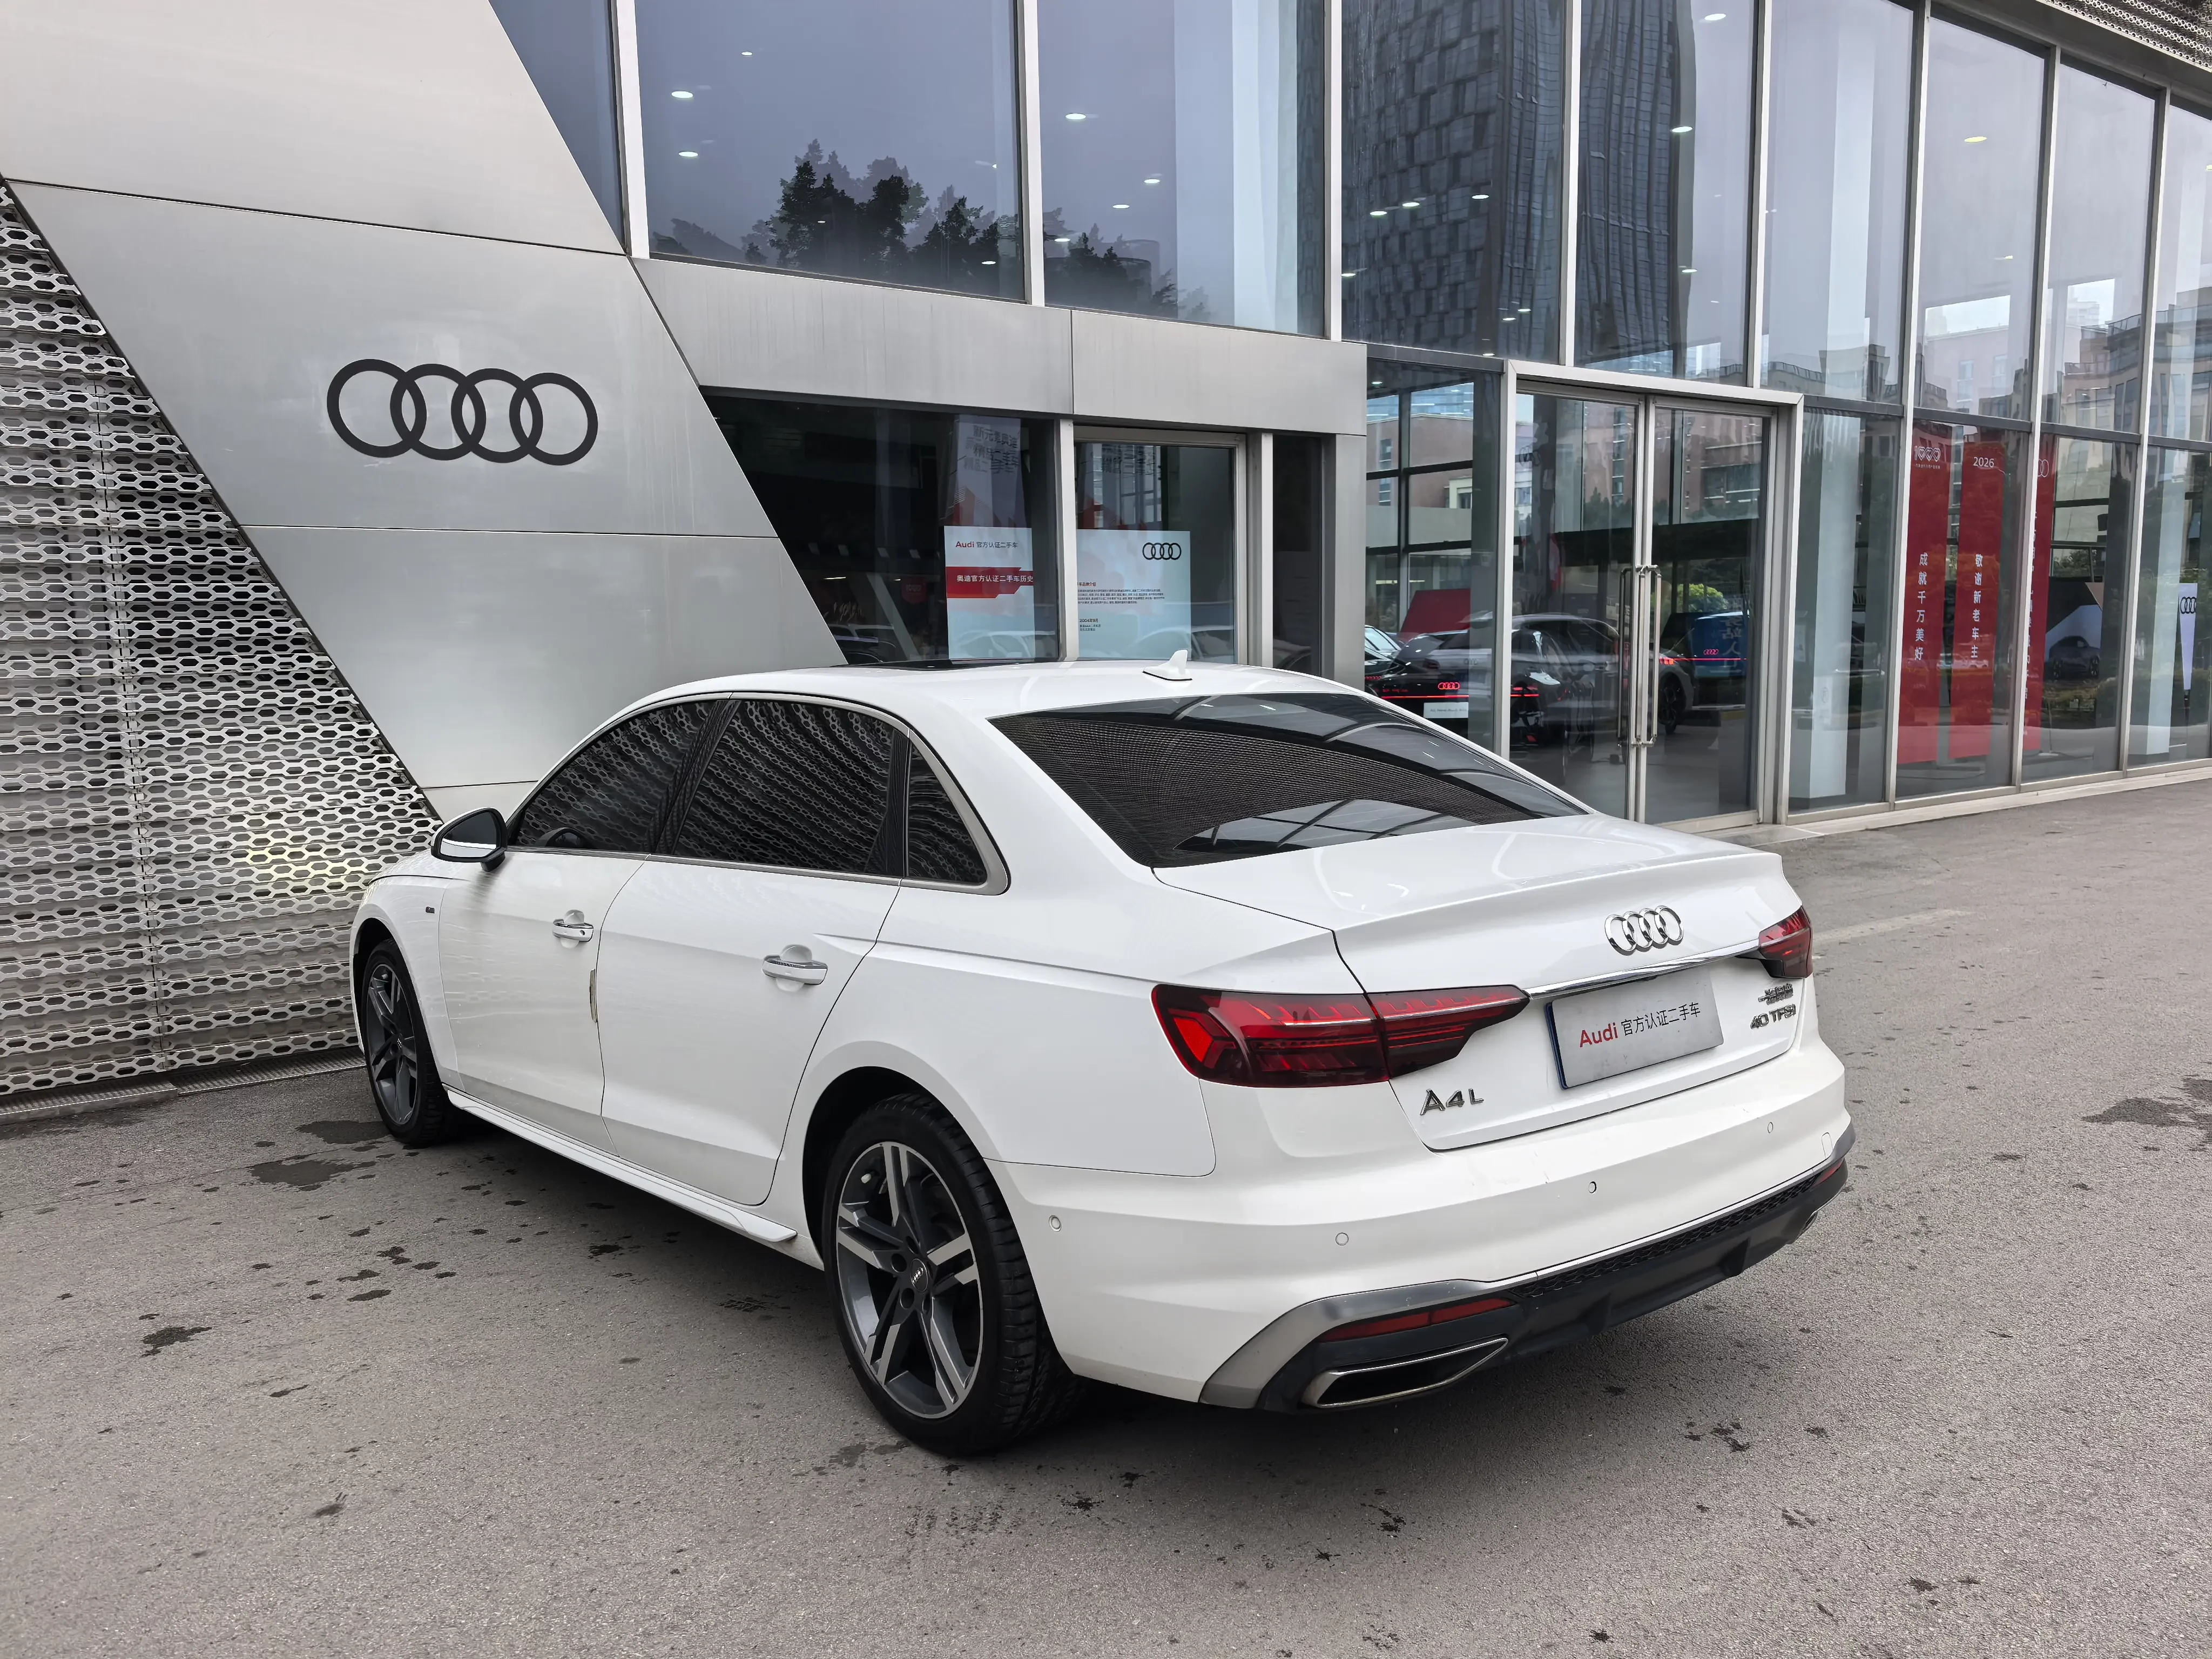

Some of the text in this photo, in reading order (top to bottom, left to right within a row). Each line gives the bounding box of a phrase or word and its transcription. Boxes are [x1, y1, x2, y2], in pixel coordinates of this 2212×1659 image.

[1973, 457, 1994, 468] 2026
[1914, 552, 1928, 660] 成就千万美好
[1971, 554, 1983, 658] 敬谢新老车主
[1580, 1002, 1701, 1048] Audi 官方认证二手车
[1750, 1003, 1796, 1029] 40 TFSI
